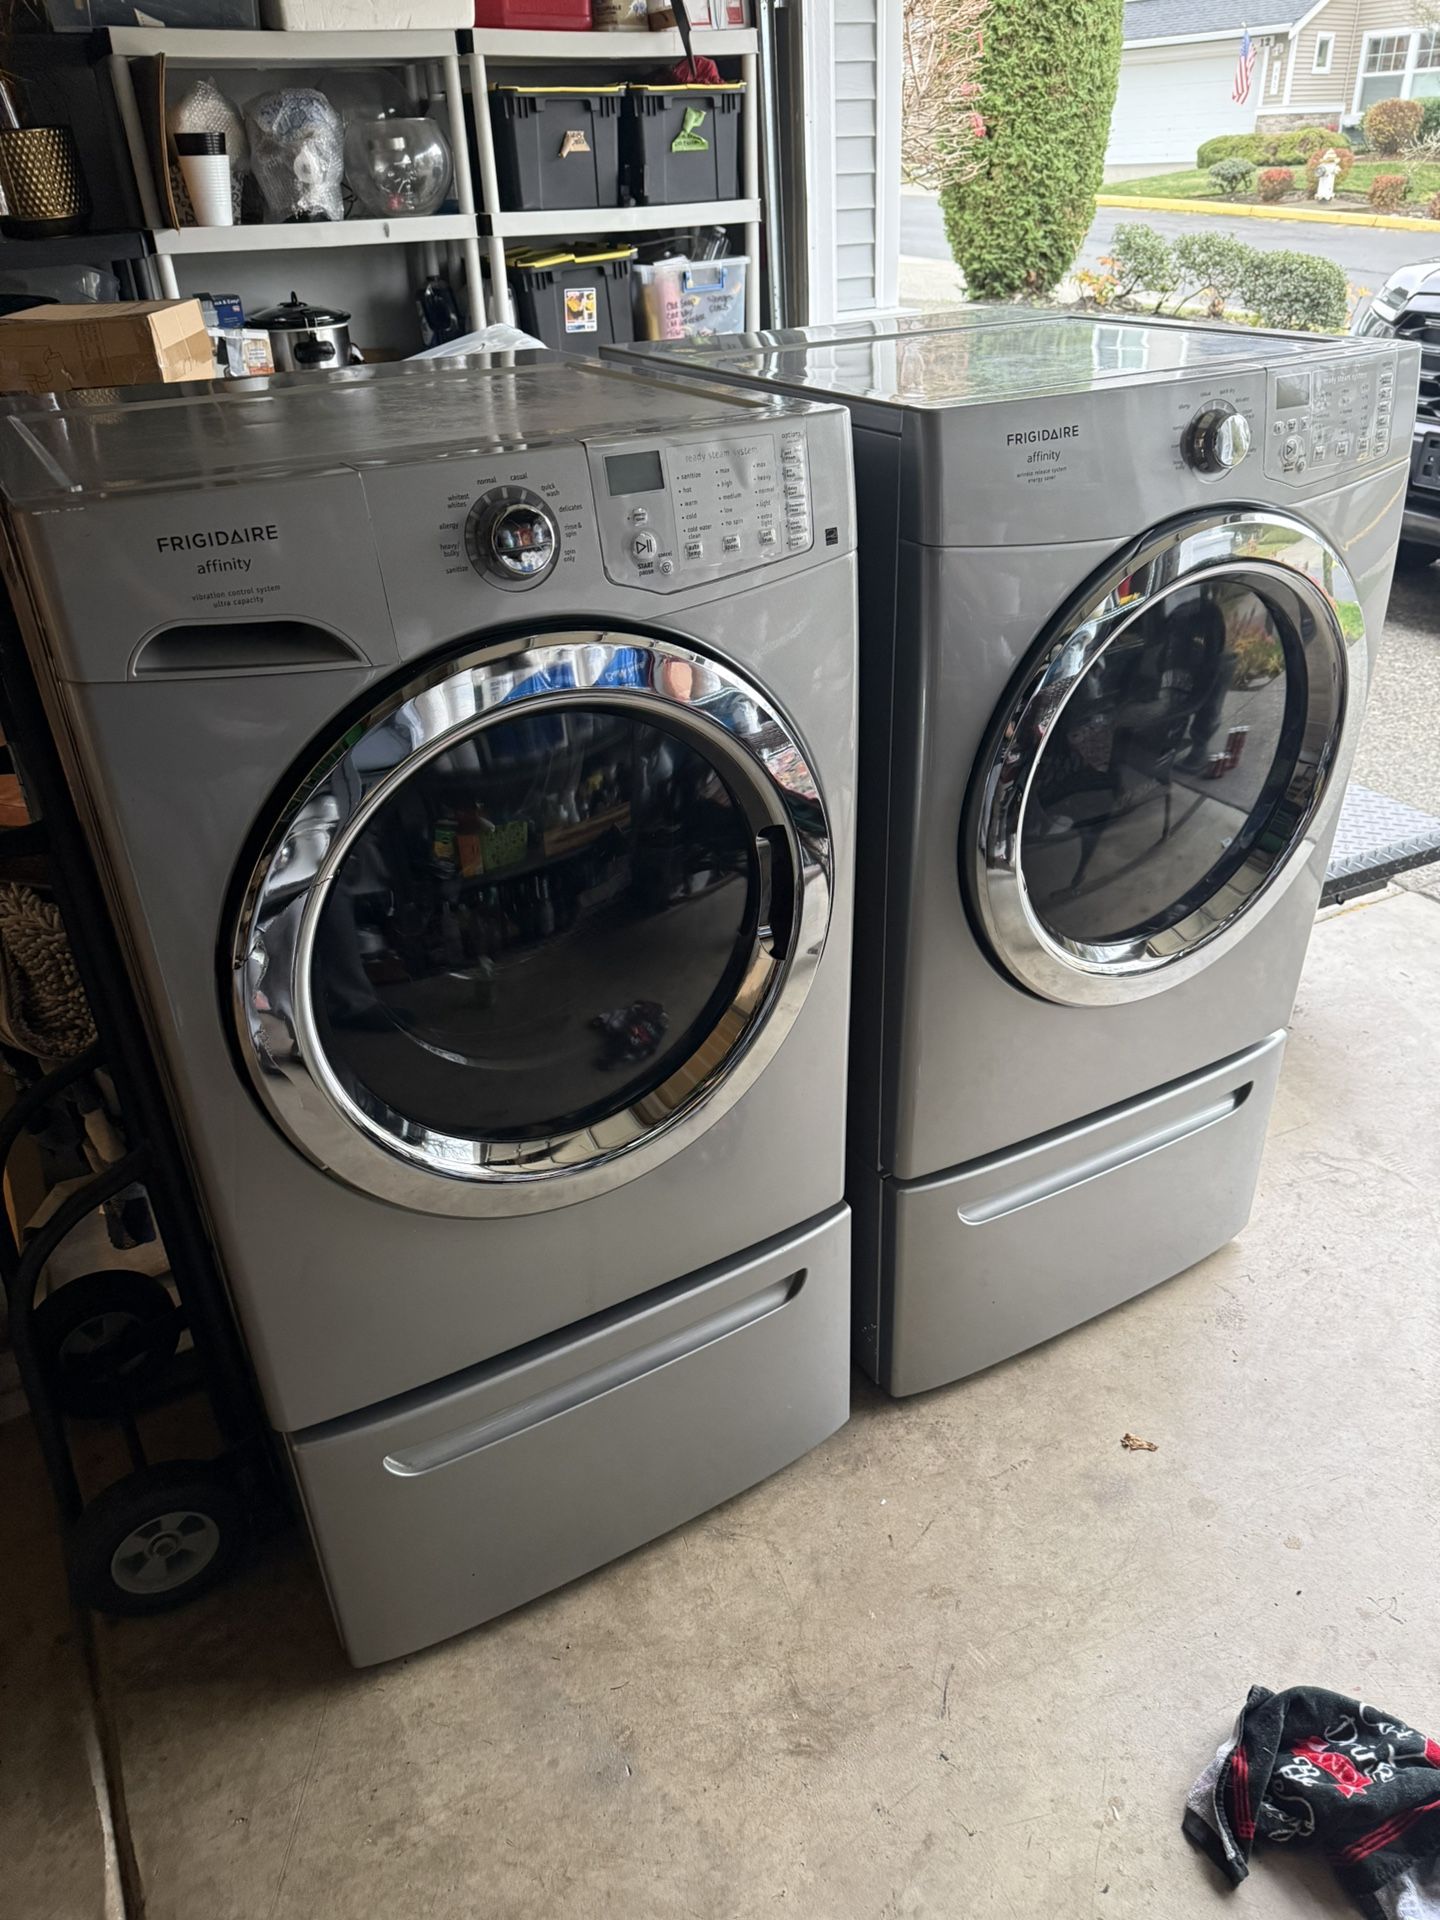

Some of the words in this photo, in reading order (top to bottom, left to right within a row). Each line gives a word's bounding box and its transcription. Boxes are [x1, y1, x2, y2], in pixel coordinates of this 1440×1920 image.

[1006, 425, 1079, 446] FRIGIDAIRE
[1026, 449, 1061, 463] affinity
[477, 476, 496, 485] normal
[510, 472, 528, 481] casual
[681, 472, 702, 480] sanitize
[541, 483, 555, 492] quick
[721, 480, 733, 488] high
[546, 489, 560, 498] wash
[758, 486, 774, 494] normal
[447, 492, 470, 501] whitest
[722, 492, 742, 500] medium
[447, 500, 467, 509] whites
[558, 503, 583, 513] delicates
[686, 512, 697, 520] cold
[439, 521, 459, 531] allergy
[156, 524, 279, 553] FRIGIDAIRE
[565, 530, 577, 538] spin
[197, 557, 252, 575] affinity
[445, 566, 469, 574] sanitize
[637, 561, 654, 570] START
[191, 591, 226, 601] vibration
[227, 587, 254, 597] control
[256, 584, 281, 594] system
[212, 599, 231, 608] ultra
[233, 596, 264, 606] capacity
